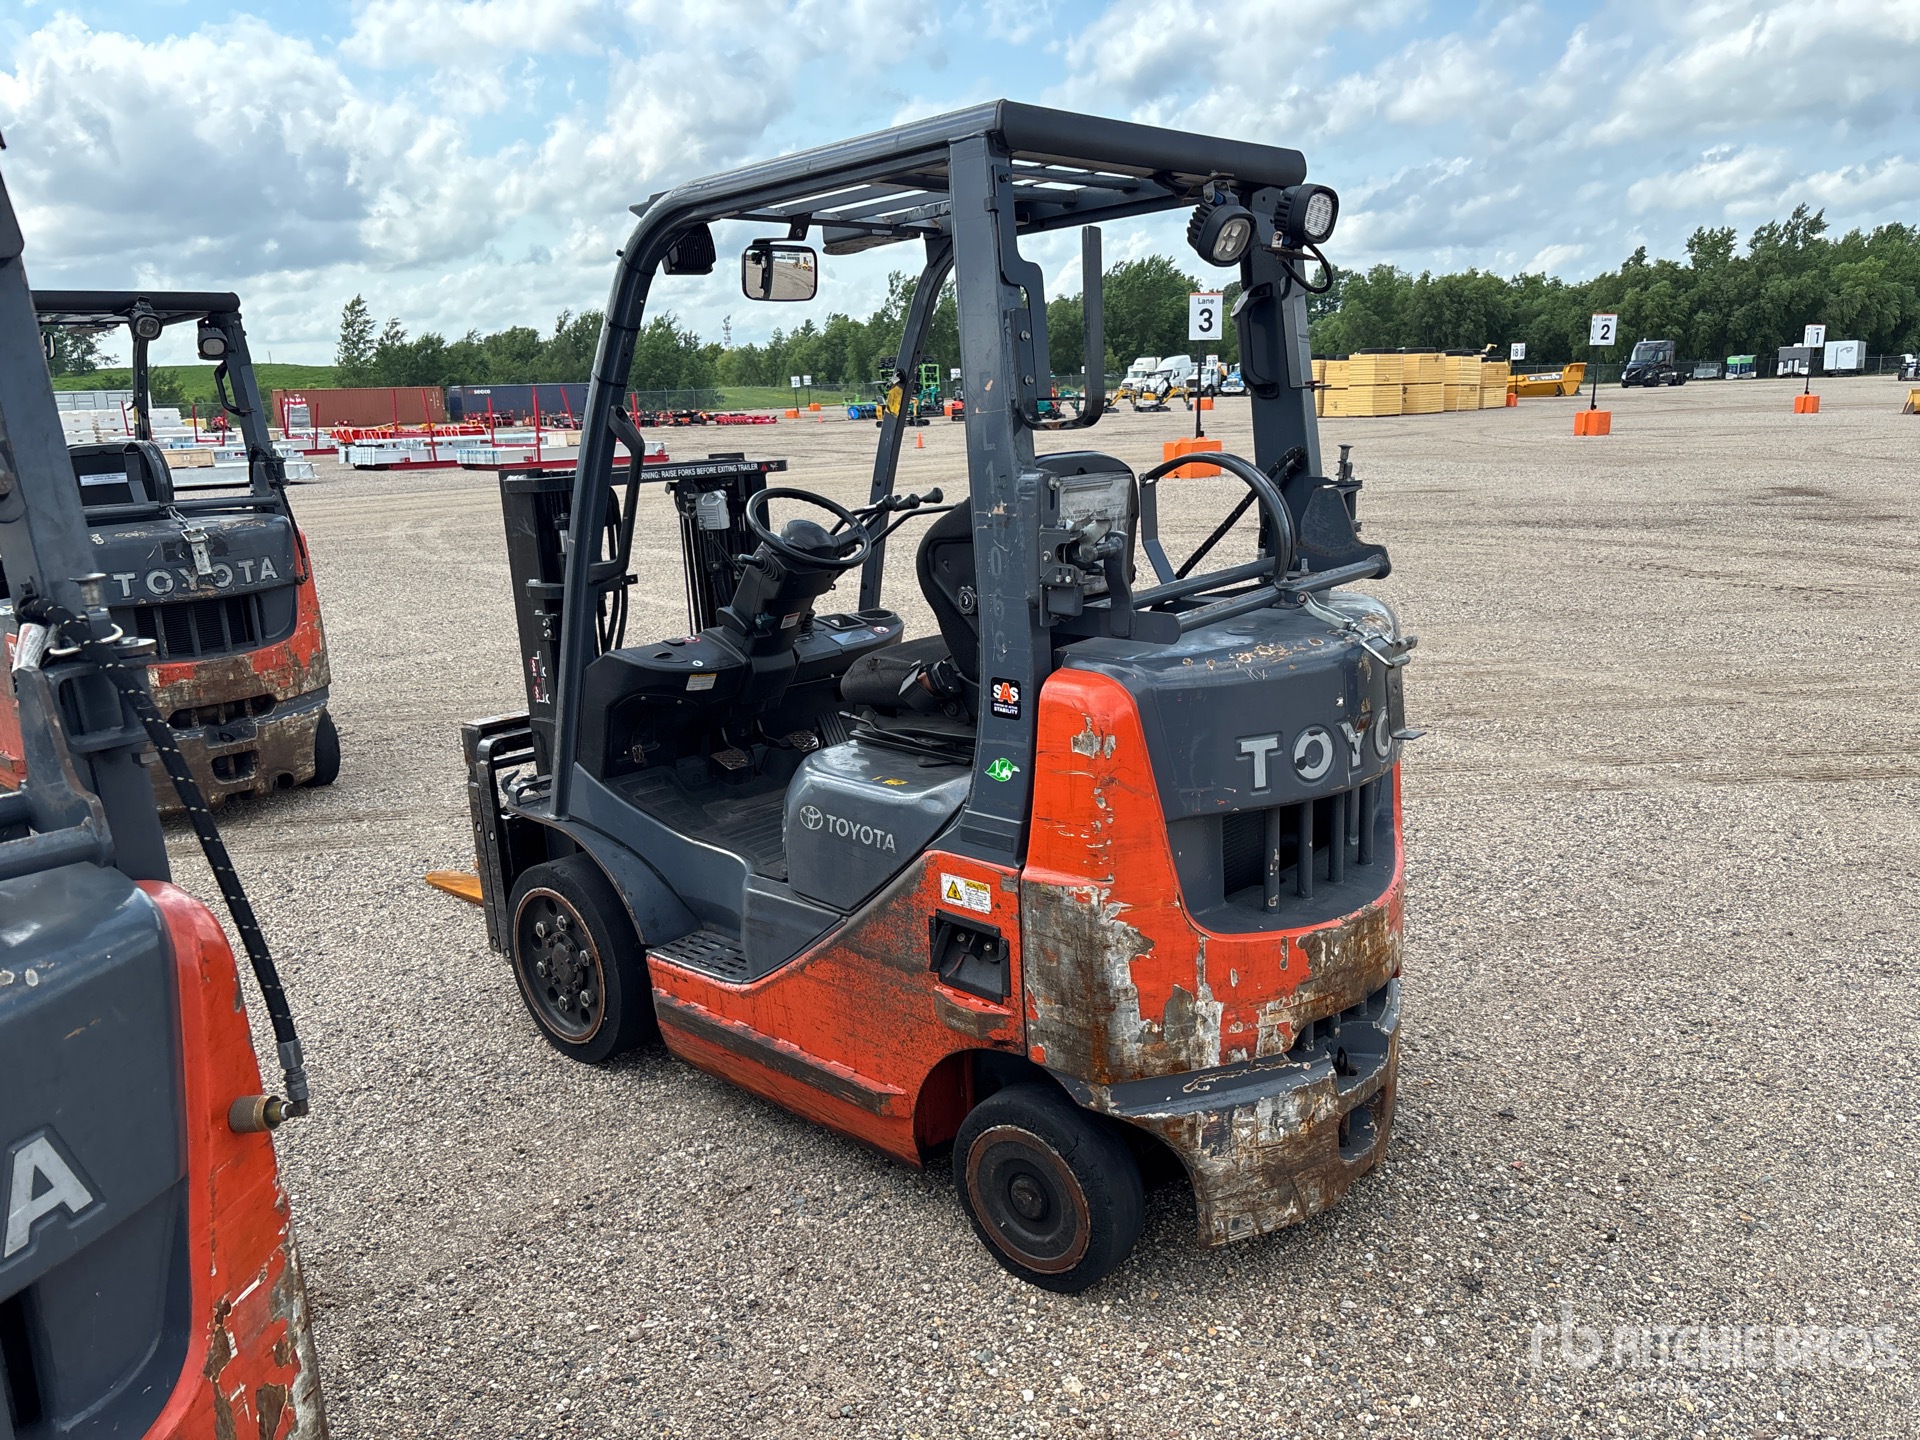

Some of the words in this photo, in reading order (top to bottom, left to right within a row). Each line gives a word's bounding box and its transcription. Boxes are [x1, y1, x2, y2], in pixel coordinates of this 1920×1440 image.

[1197, 297, 1215, 305] Lane
[1198, 307, 1213, 333] 3
[1600, 323, 1610, 340] 2
[1815, 331, 1820, 344] 1
[1512, 348, 1519, 357] 18
[641, 470, 661, 480] RNING:
[661, 469, 678, 478] RAISE
[678, 467, 696, 477] FORKS
[696, 466, 717, 475] BEFORE
[717, 464, 738, 474] EXITING
[738, 462, 759, 471] TRAILER
[112, 555, 279, 598] TOYOTA
[992, 682, 1019, 704] SAS
[993, 706, 1018, 715] STABILITY
[826, 813, 897, 854] TOYOTA
